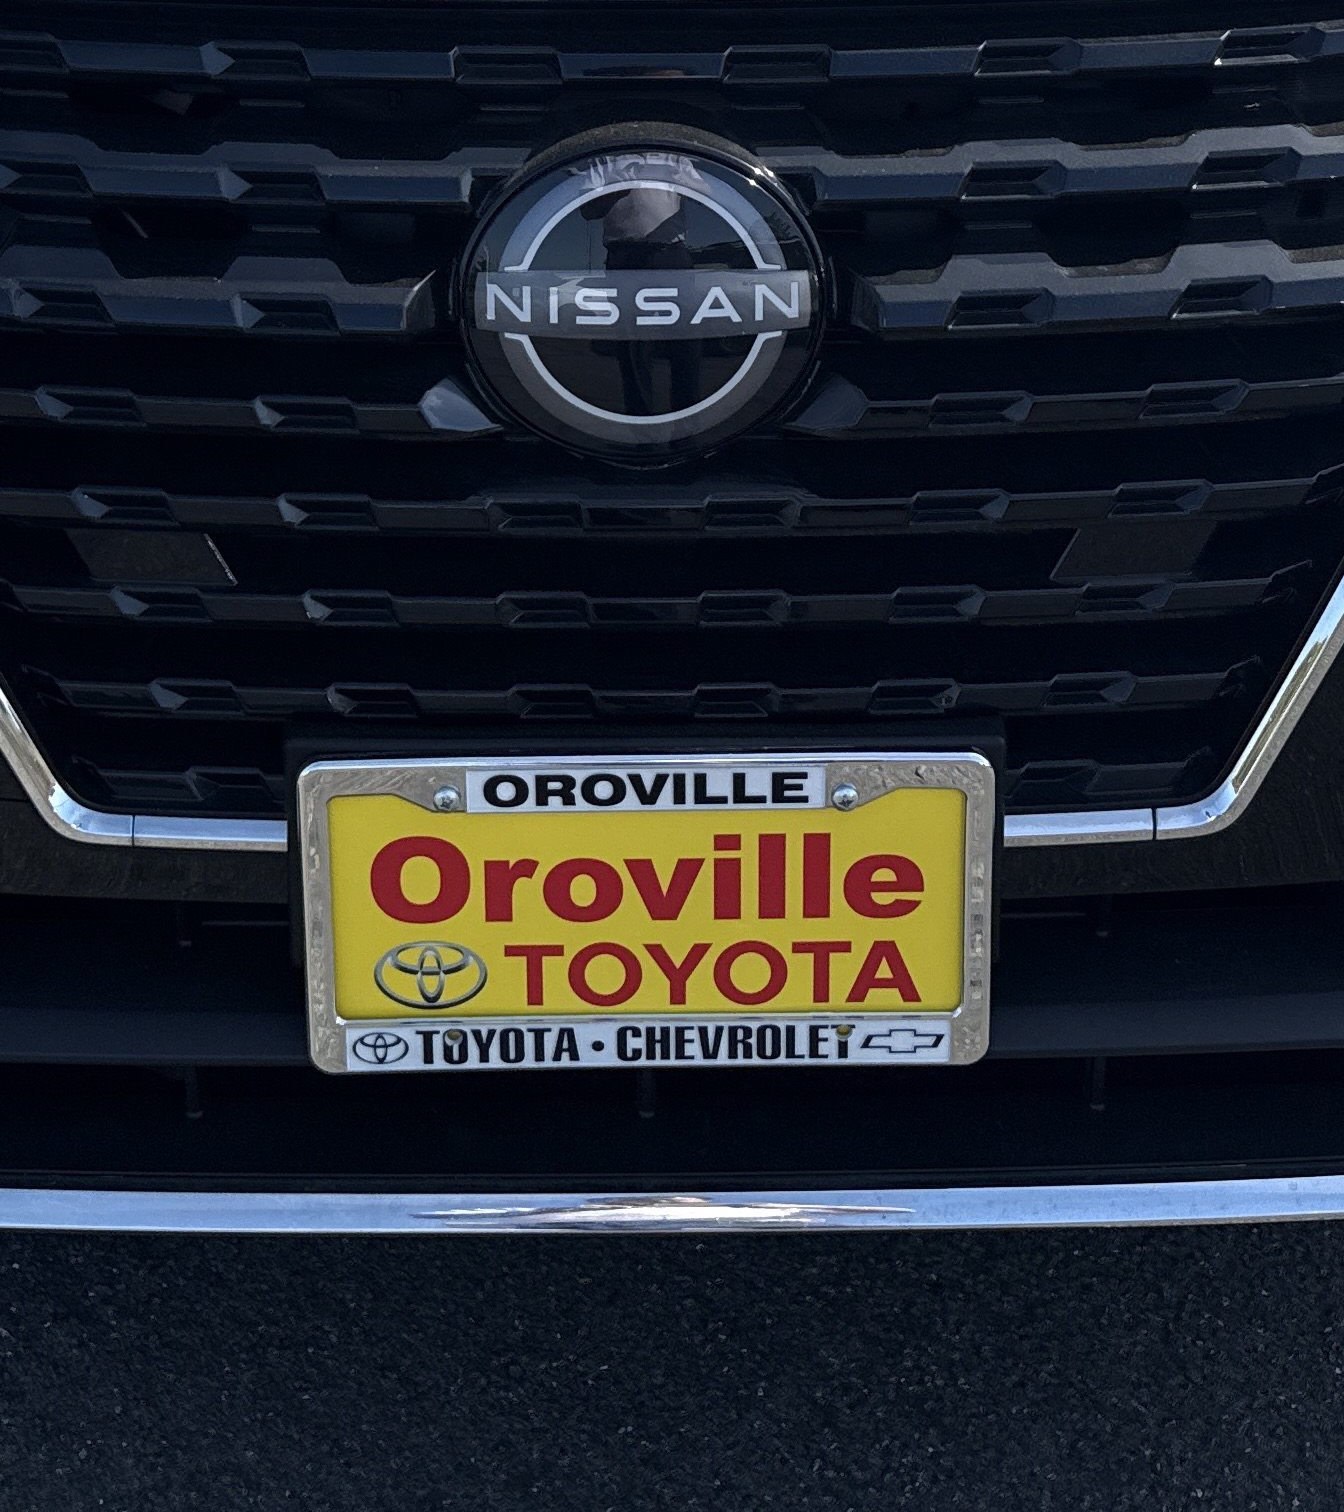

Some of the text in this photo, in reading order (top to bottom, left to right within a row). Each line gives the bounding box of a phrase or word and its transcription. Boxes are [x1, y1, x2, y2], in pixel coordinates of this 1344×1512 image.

[486, 281, 799, 326] NISSAN
[483, 771, 809, 807] OROVILLE
[370, 833, 925, 924] Oroville
[504, 940, 922, 1007] TOYOTA
[416, 1024, 855, 1064] TOYOTA CHEVROLET
